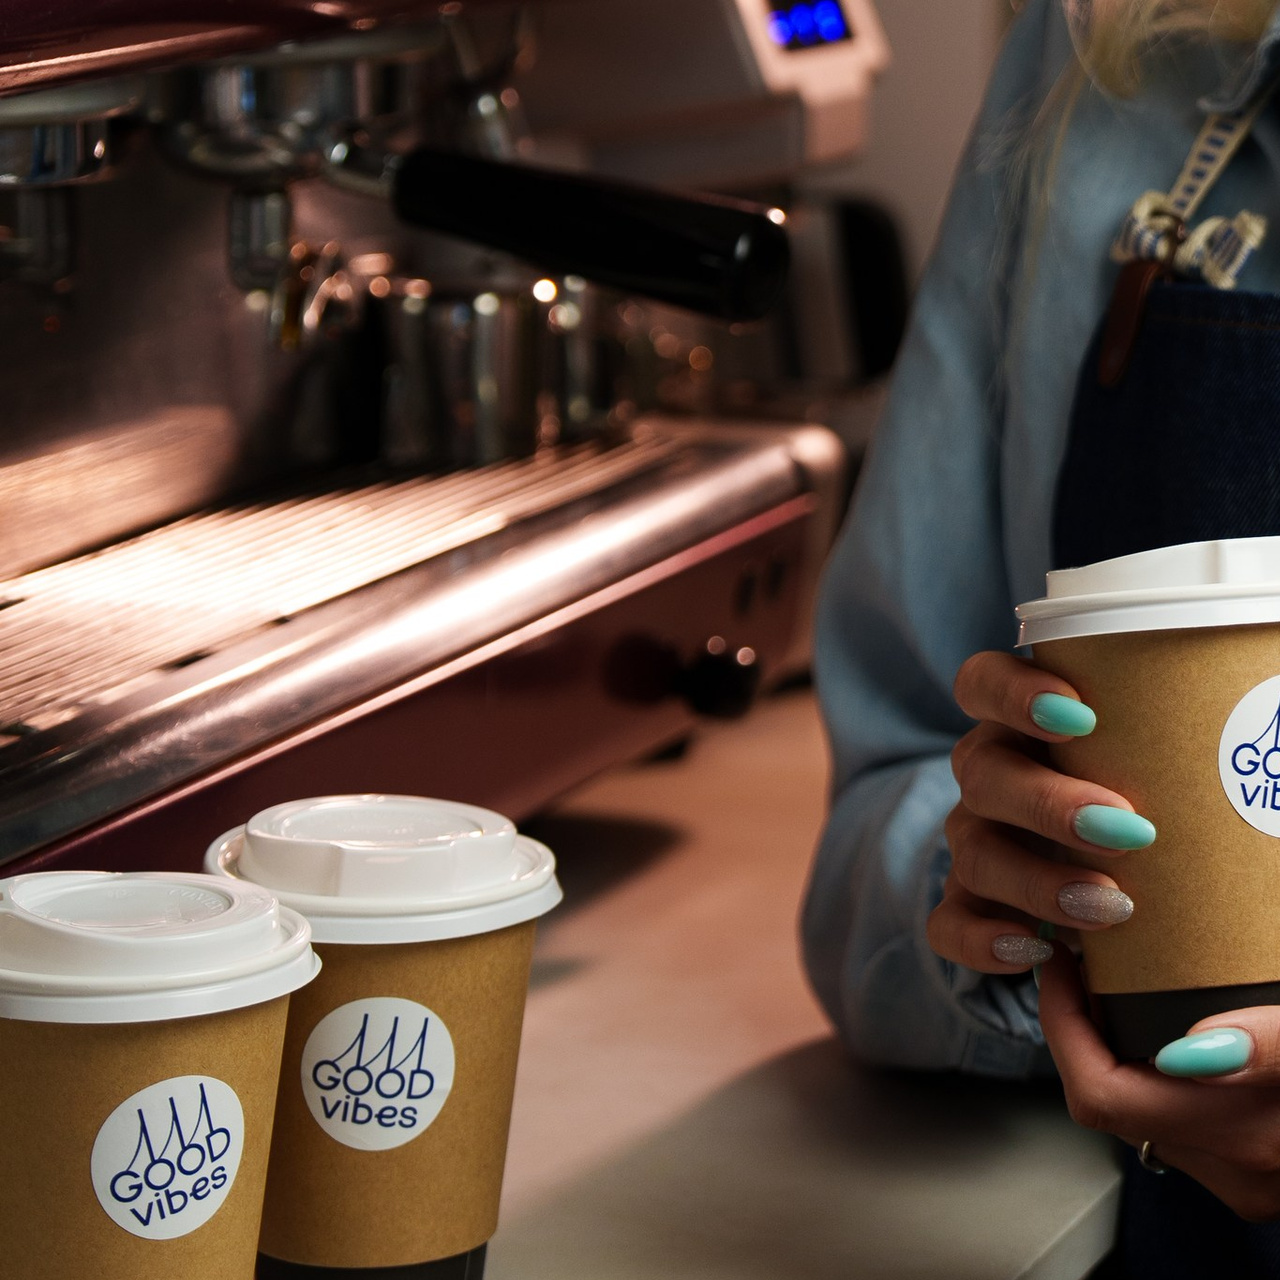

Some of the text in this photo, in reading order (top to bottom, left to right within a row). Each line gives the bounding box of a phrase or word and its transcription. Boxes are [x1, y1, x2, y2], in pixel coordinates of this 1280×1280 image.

[320, 1094, 418, 1128] vibes
[110, 1127, 231, 1203] GOOD
[129, 1165, 228, 1227] vibes
